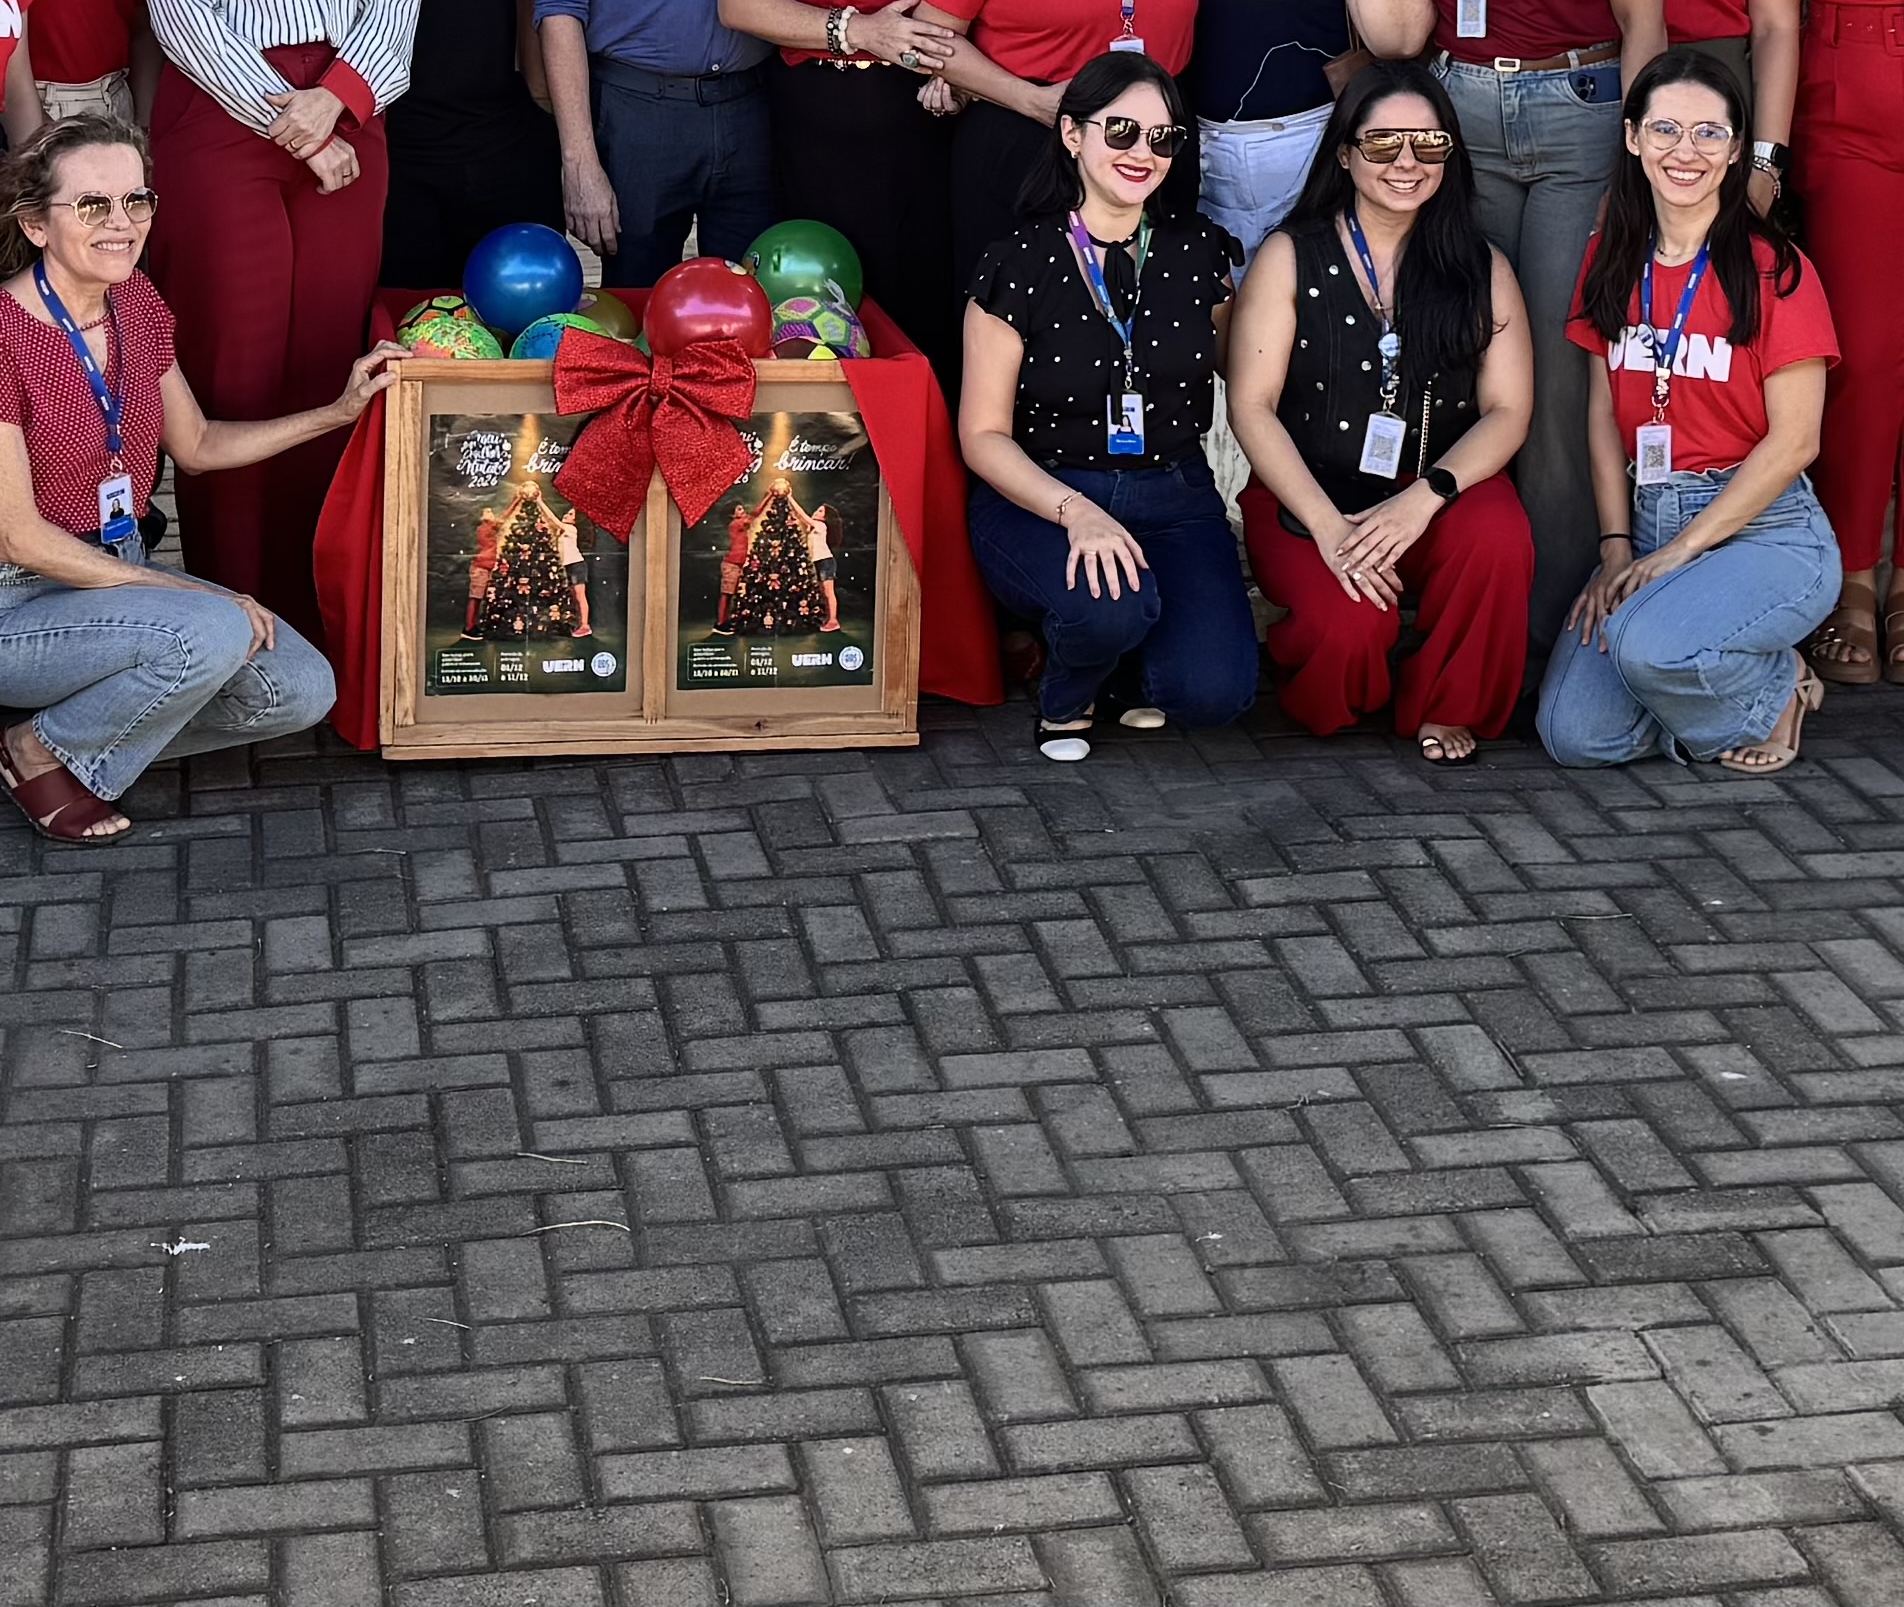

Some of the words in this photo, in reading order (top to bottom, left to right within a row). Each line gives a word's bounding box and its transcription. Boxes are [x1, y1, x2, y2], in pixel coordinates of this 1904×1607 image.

[773, 450, 854, 472] brincar!
[542, 659, 585, 673] UERN
[791, 653, 833, 667] UERN
